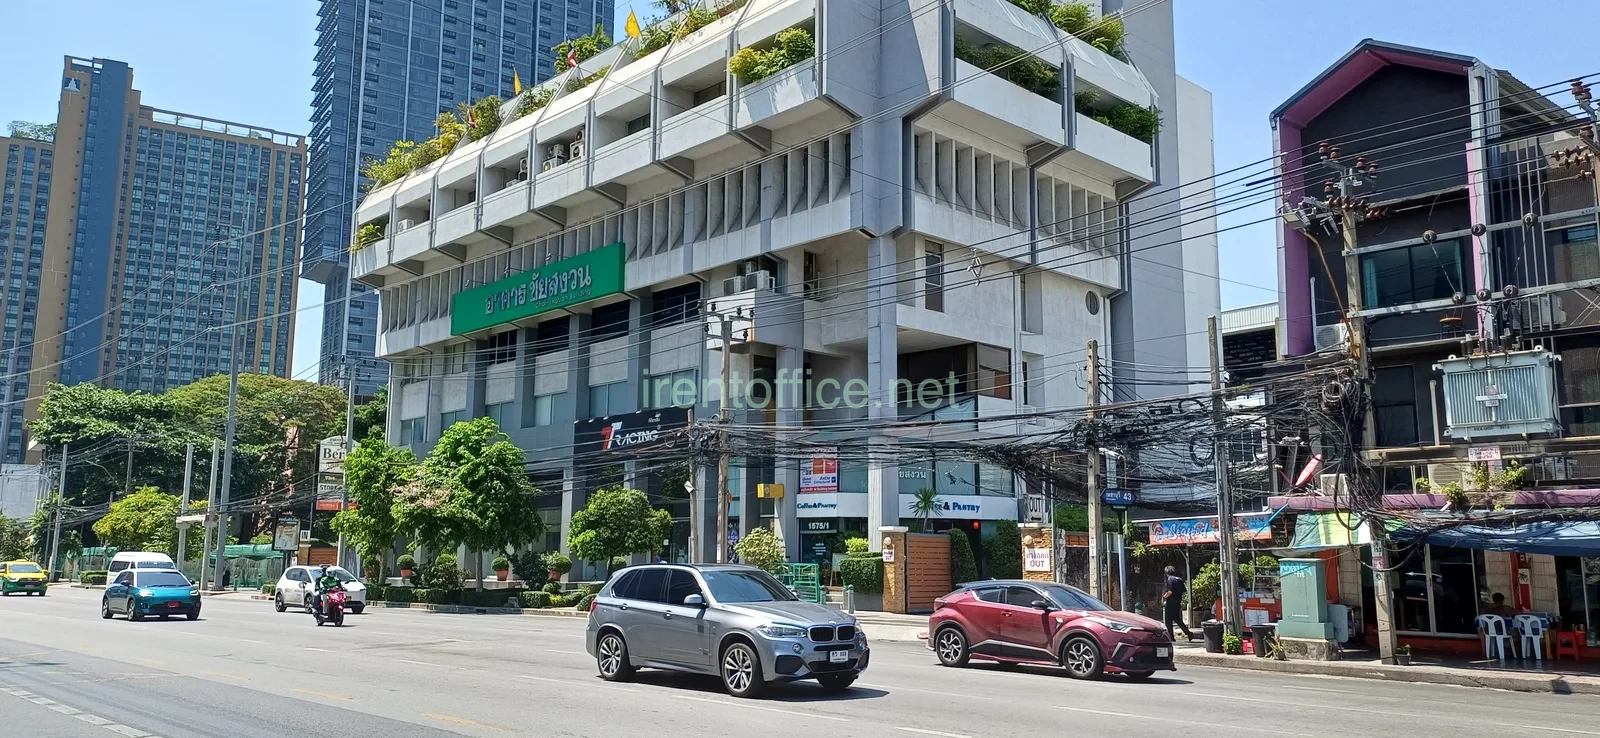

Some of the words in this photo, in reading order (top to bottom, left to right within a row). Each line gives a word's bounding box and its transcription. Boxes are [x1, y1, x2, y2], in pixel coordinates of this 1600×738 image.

[485, 283, 527, 315] อาคาร
[529, 264, 592, 302] ชัยสงวน
[1122, 492, 1132, 500] 43
[1029, 496, 1041, 513] OUT
[808, 522, 830, 530] 1575/1
[1029, 560, 1045, 568] OUT
